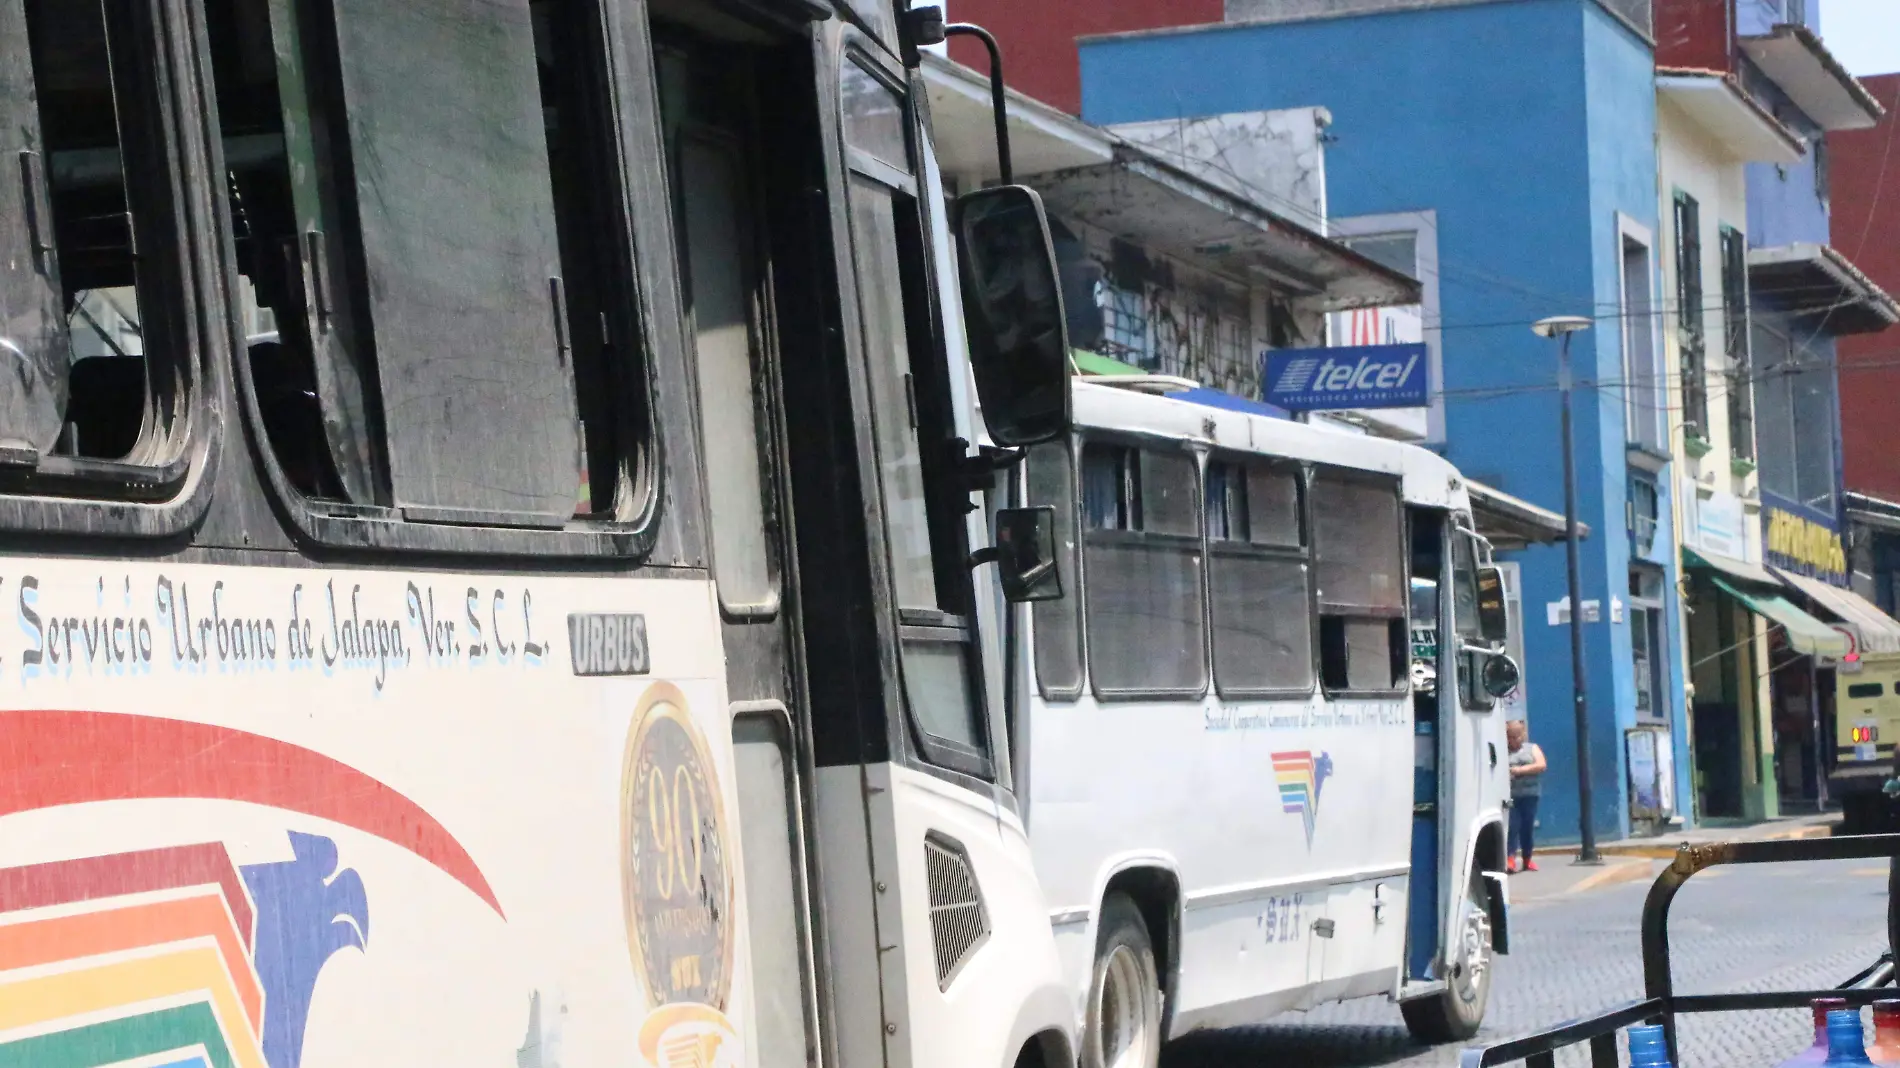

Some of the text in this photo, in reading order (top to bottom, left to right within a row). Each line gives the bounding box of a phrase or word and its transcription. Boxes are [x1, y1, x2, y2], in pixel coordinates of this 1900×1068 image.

[1312, 354, 1419, 391] telcel
[20, 575, 152, 667] Servicio
[157, 574, 276, 664] Urbano
[288, 583, 313, 660] de
[321, 577, 411, 692] Jalapa,
[407, 580, 460, 657] Ver.
[574, 613, 646, 675] URBUS
[650, 764, 700, 900] 90
